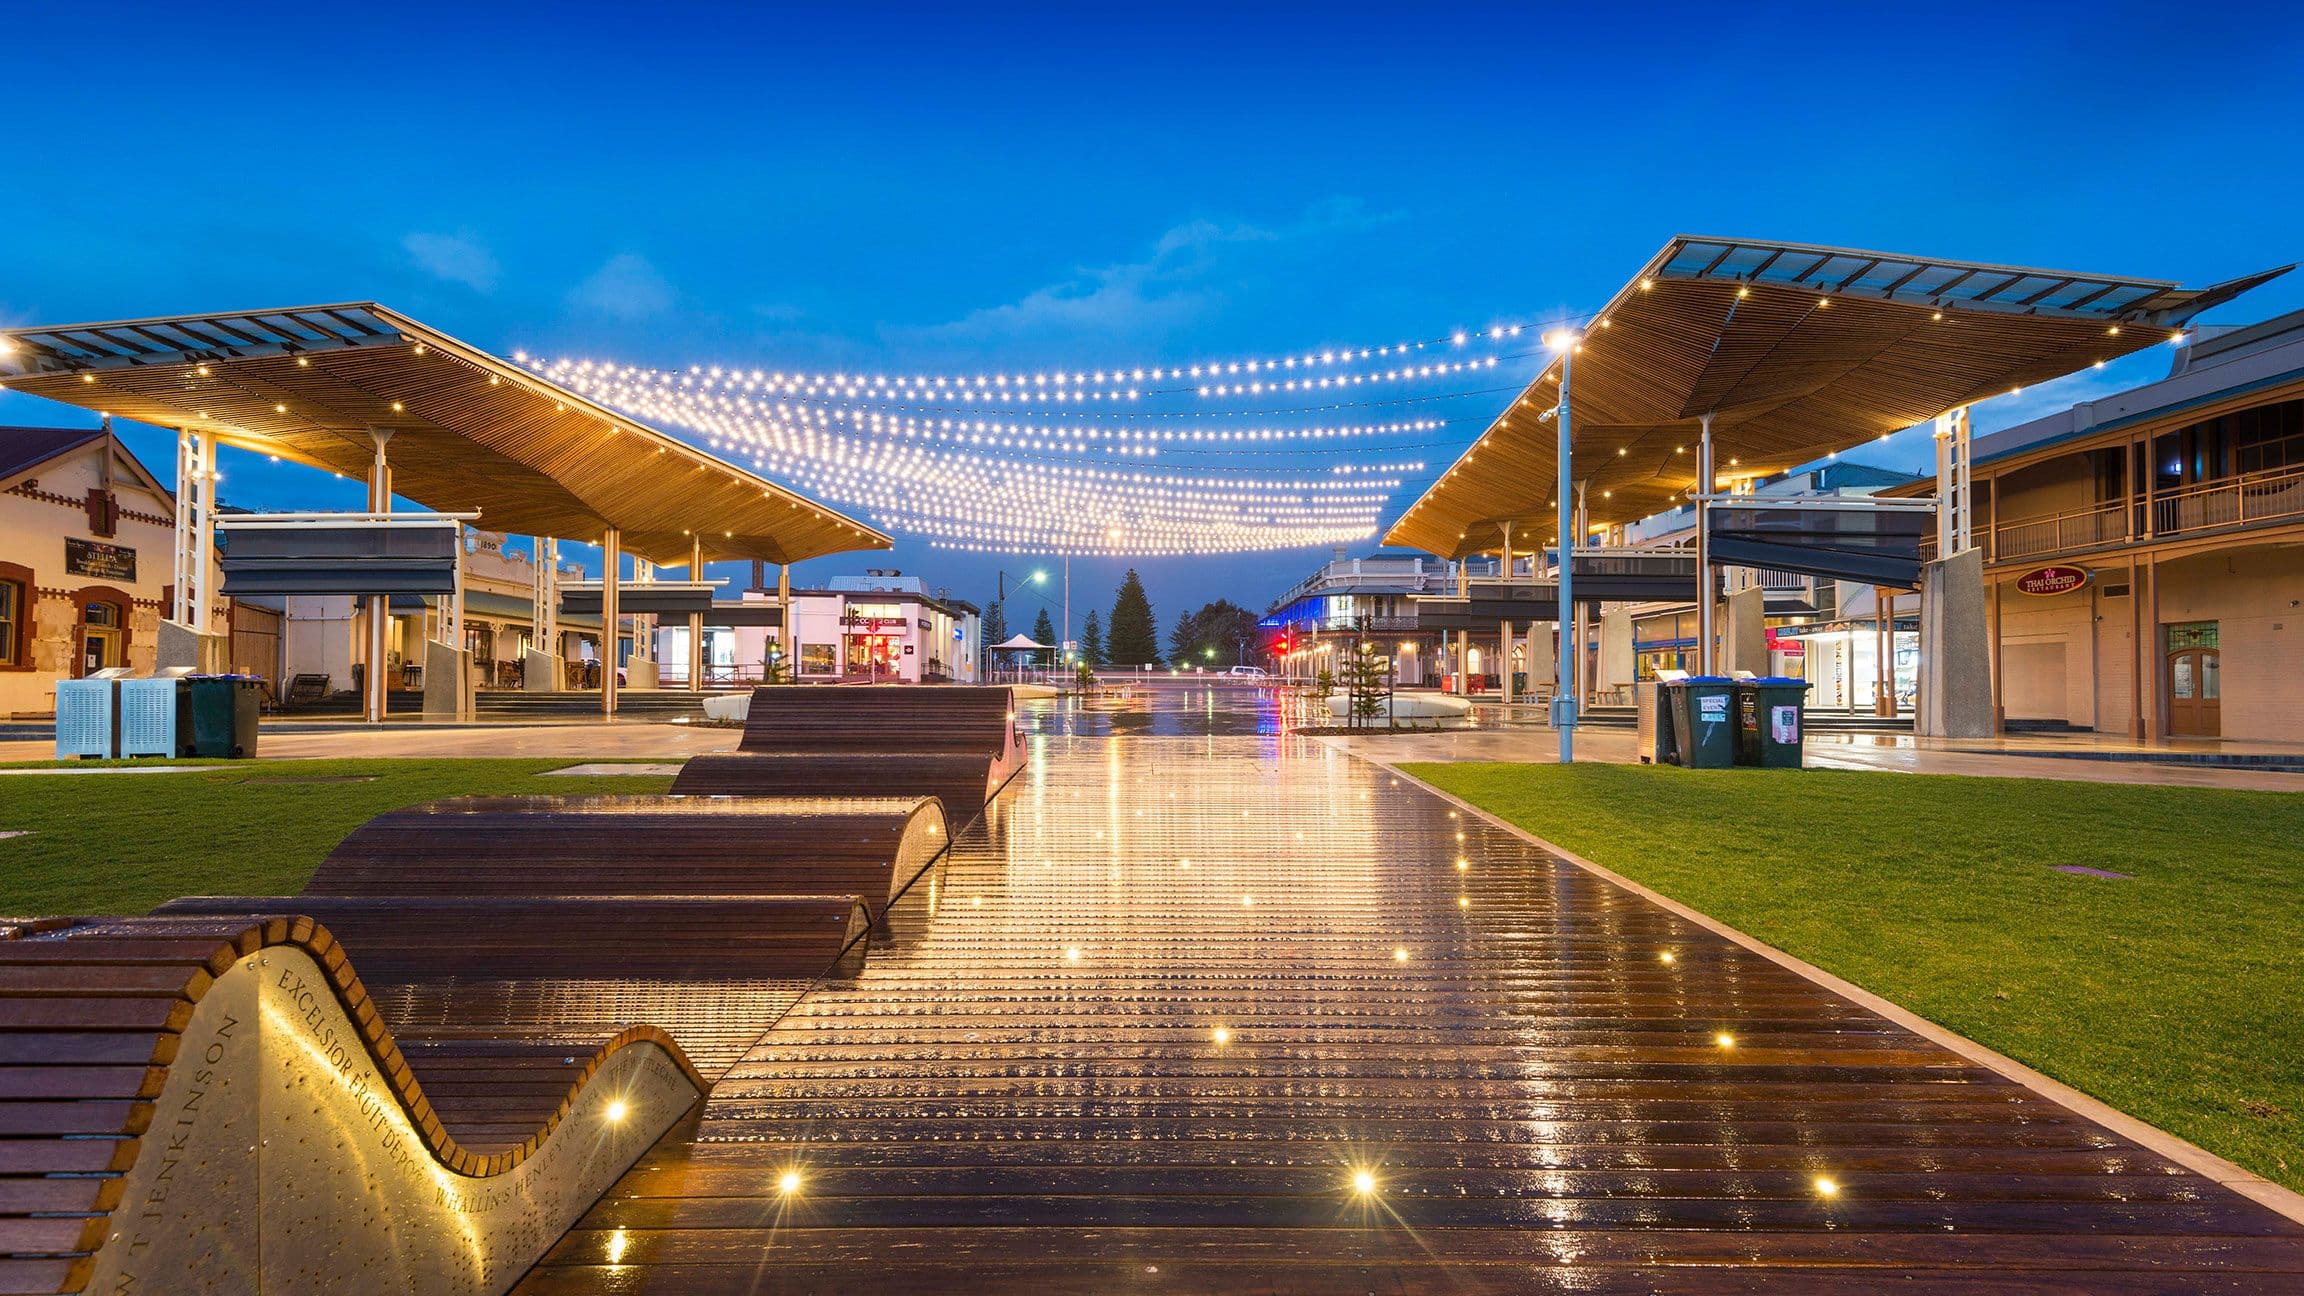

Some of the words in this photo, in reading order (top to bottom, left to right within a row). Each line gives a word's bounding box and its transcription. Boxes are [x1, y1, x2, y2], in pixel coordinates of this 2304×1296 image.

[480, 541, 497, 551] 1890
[2026, 579, 2044, 588] THAI
[2045, 575, 2076, 586] ORCHID
[2027, 582, 2076, 592] RESTAURANT
[277, 968, 353, 1080] EXCELSIOR
[349, 1073, 388, 1133] FRUIT
[128, 1233, 150, 1257] T
[142, 1013, 239, 1225] JENKINSON
[514, 1139, 564, 1196] HENLEY
